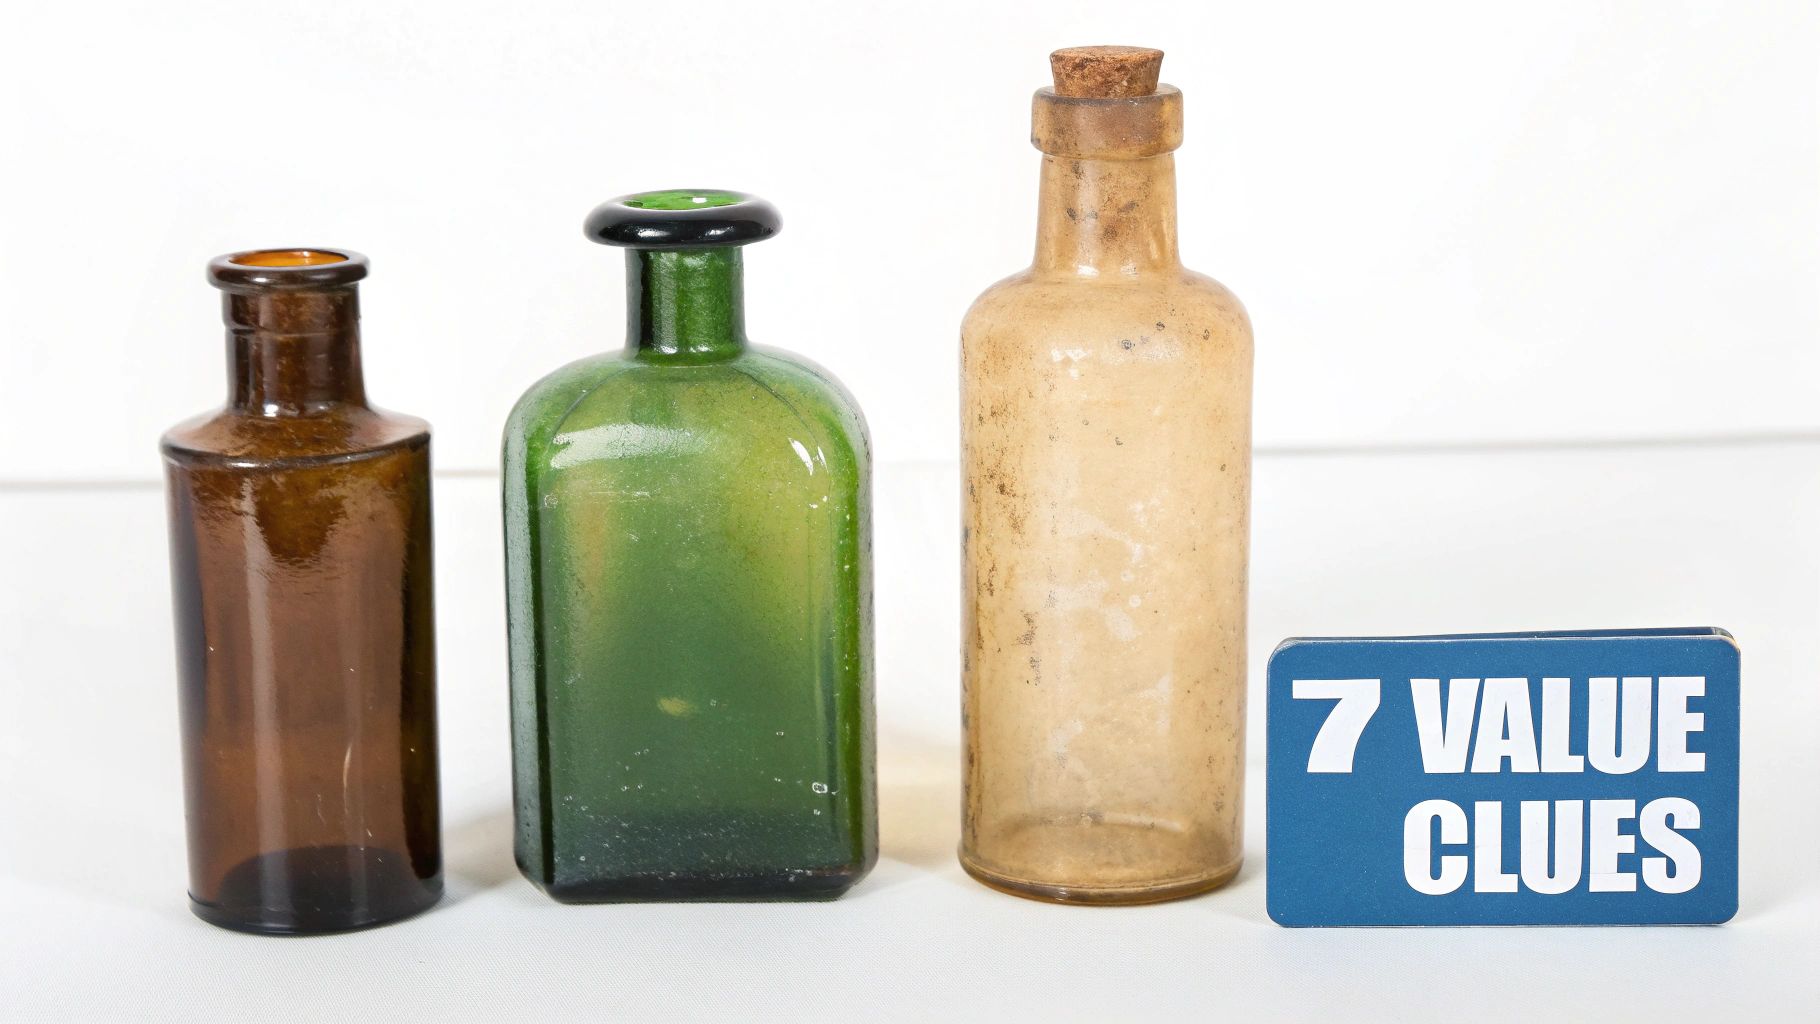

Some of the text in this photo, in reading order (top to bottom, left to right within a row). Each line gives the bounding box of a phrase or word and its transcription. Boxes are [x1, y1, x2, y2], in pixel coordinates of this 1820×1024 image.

[1292, 676, 1706, 775] 7 VALUE
[1403, 797, 1702, 896] CLUES
